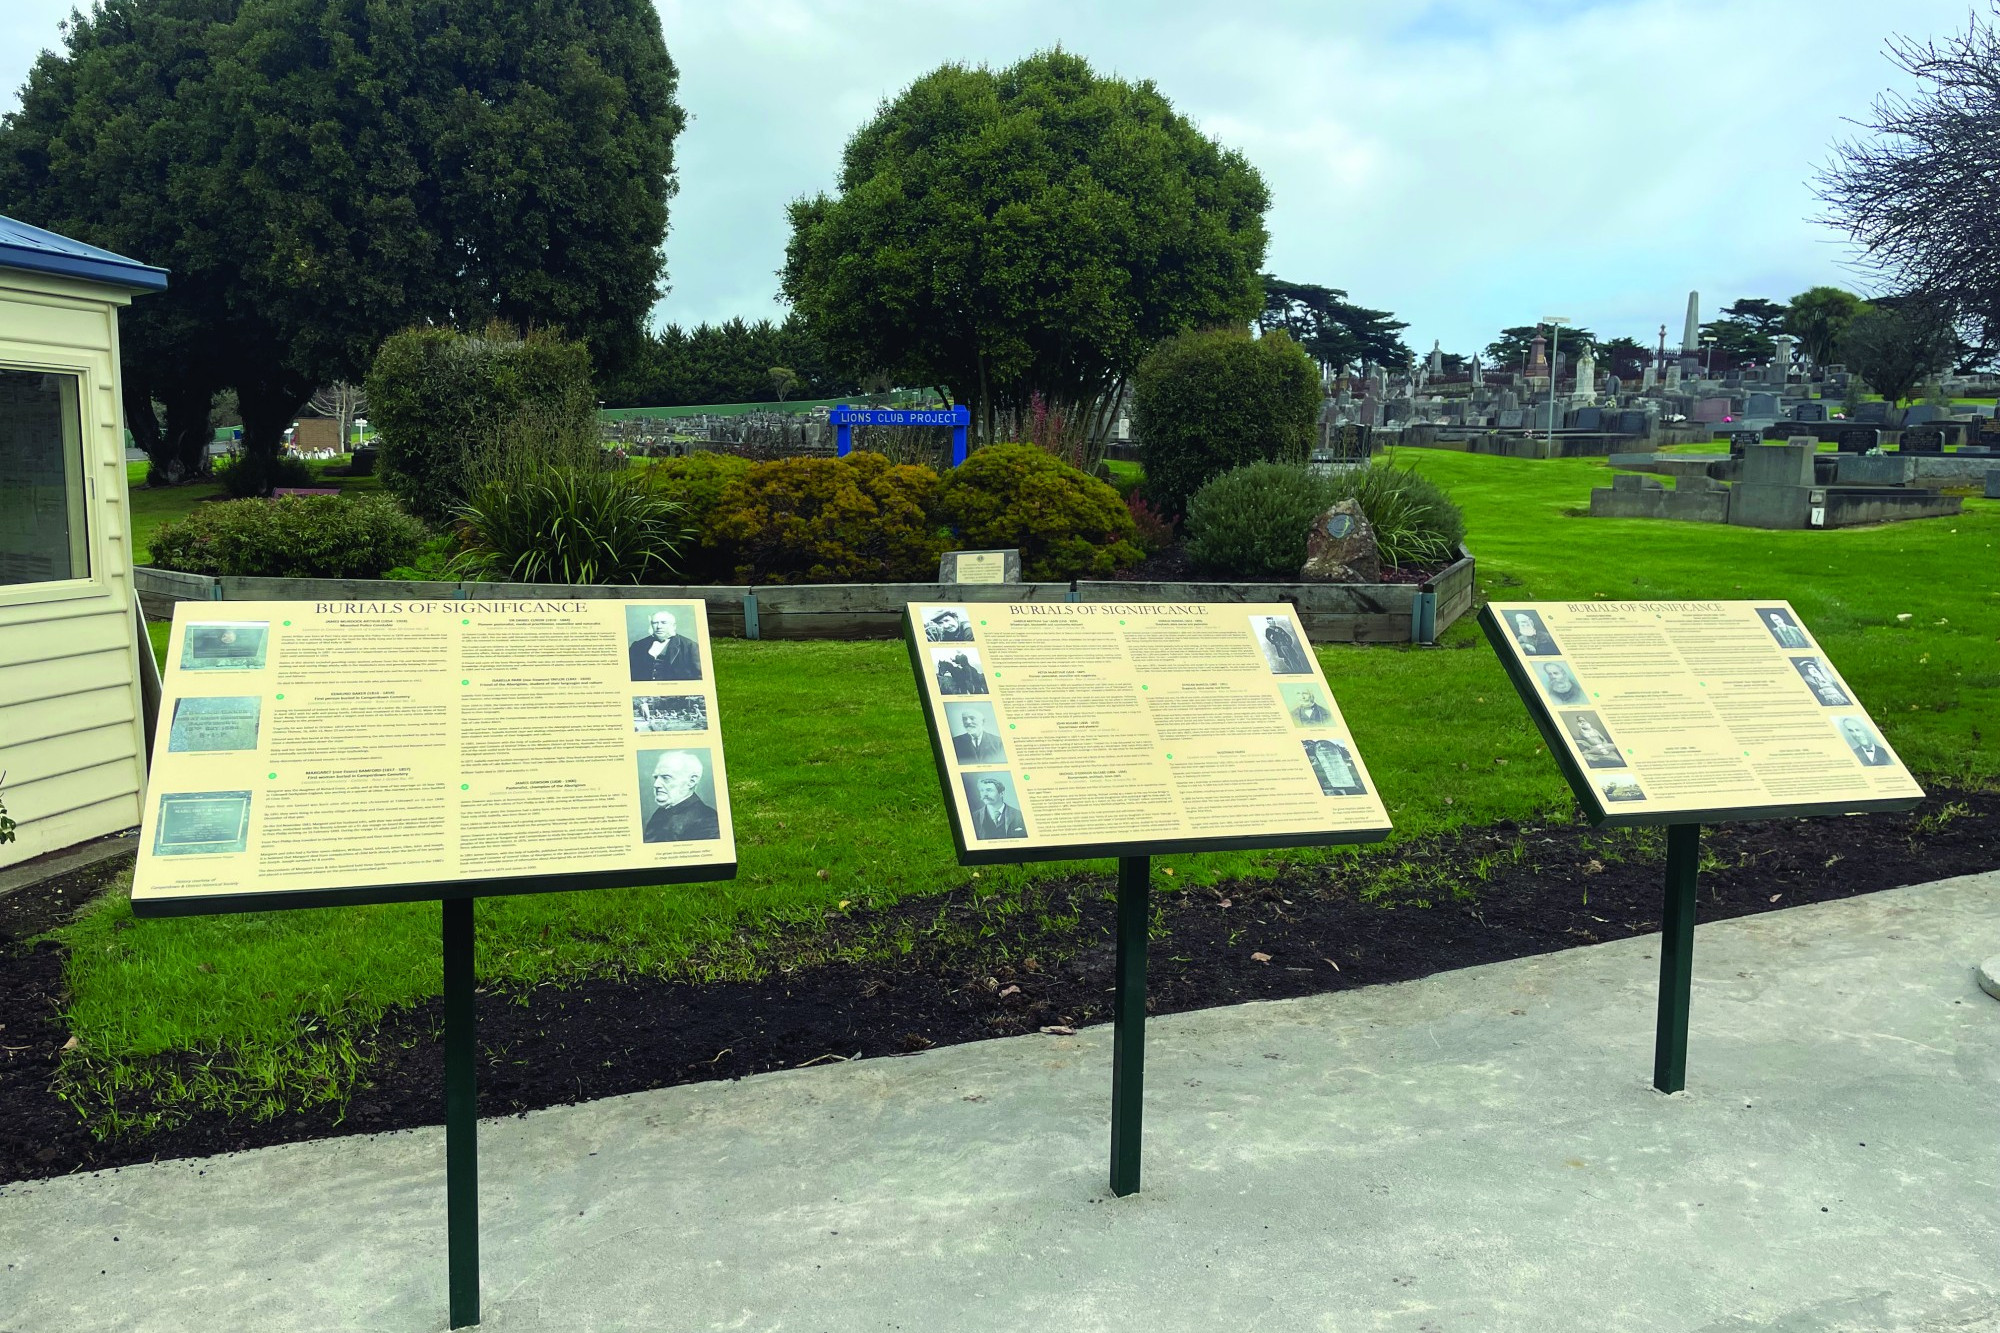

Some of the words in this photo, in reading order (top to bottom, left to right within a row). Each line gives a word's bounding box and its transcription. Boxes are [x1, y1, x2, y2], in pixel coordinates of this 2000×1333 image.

[841, 413, 871, 422] LIONS
[878, 413, 904, 422] CLUB
[910, 413, 958, 422] PROJECT
[316, 603, 403, 613] BURIALS
[409, 603, 438, 613] OF
[442, 603, 588, 613] SIGNIFICANCE
[1010, 605, 1074, 615] BURIALS
[1077, 605, 1098, 614] OF
[1101, 605, 1208, 614] SIGNIFICANCE
[1567, 603, 1619, 612] BURIALS
[1620, 603, 1637, 612] OF
[1639, 602, 1725, 612] SIGNIFICANCE
